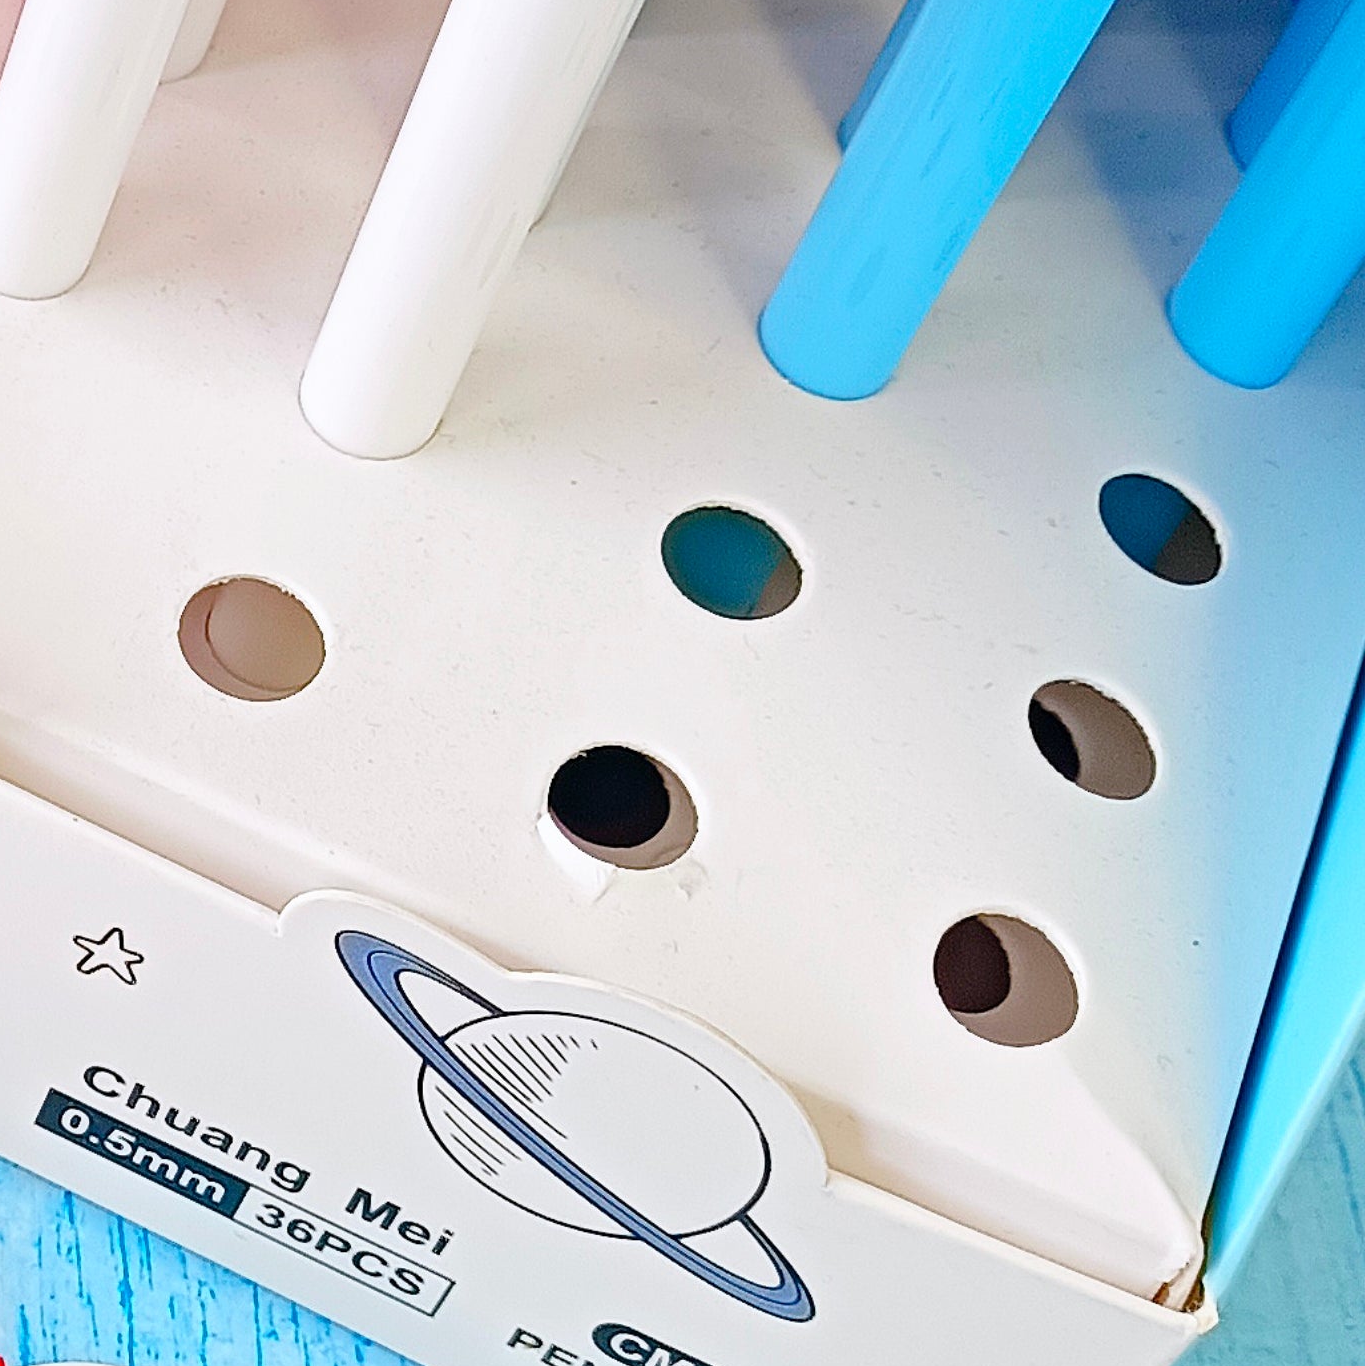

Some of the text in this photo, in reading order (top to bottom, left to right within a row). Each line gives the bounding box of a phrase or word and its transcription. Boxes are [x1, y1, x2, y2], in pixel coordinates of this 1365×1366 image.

[60, 1107, 425, 1297] 0.5mm 36PCS
[83, 1065, 454, 1255] Chuang Mei
